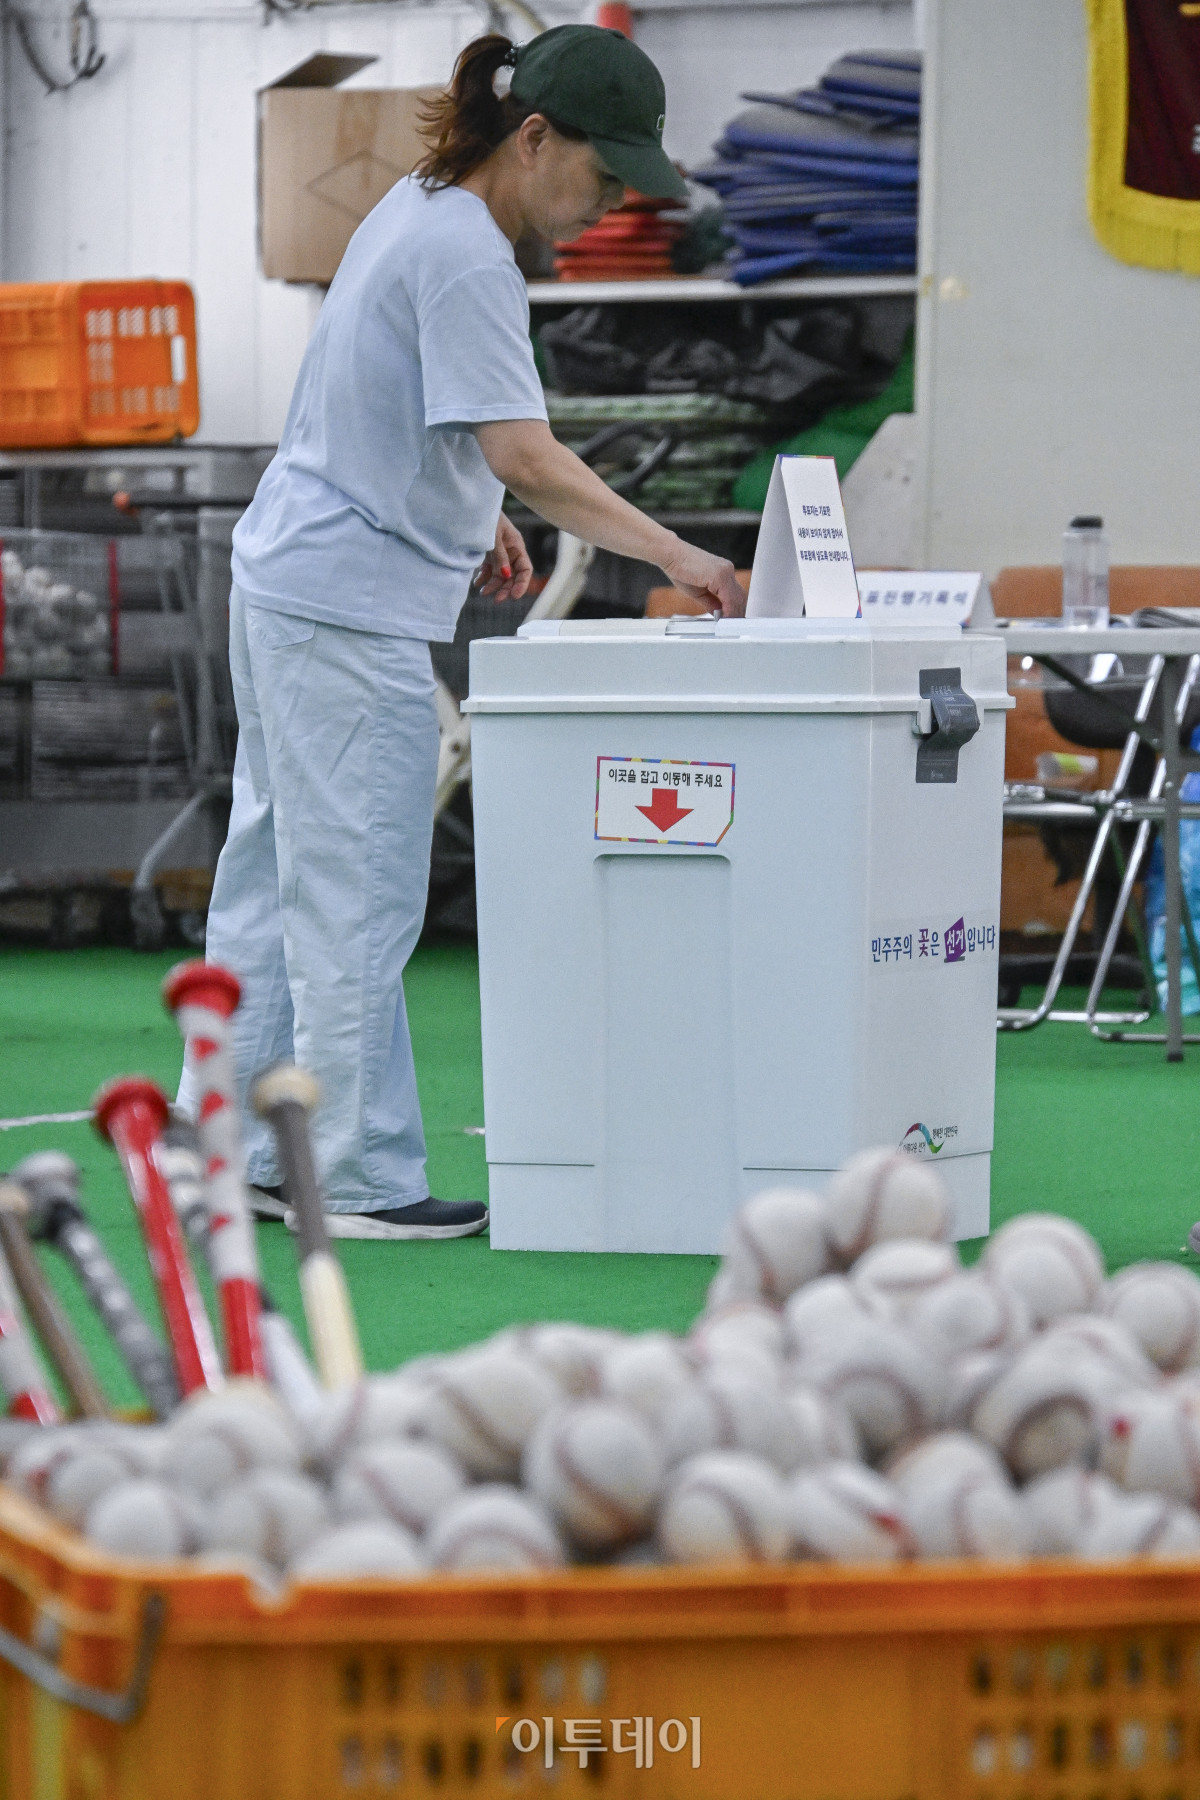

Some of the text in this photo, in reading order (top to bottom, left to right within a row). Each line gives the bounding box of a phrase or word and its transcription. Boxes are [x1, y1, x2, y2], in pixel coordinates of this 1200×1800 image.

[608, 768, 723, 788] 이곳을 잡고 이동해 주세요
[871, 924, 996, 963] 민주주의 꽃은 선거입니다
